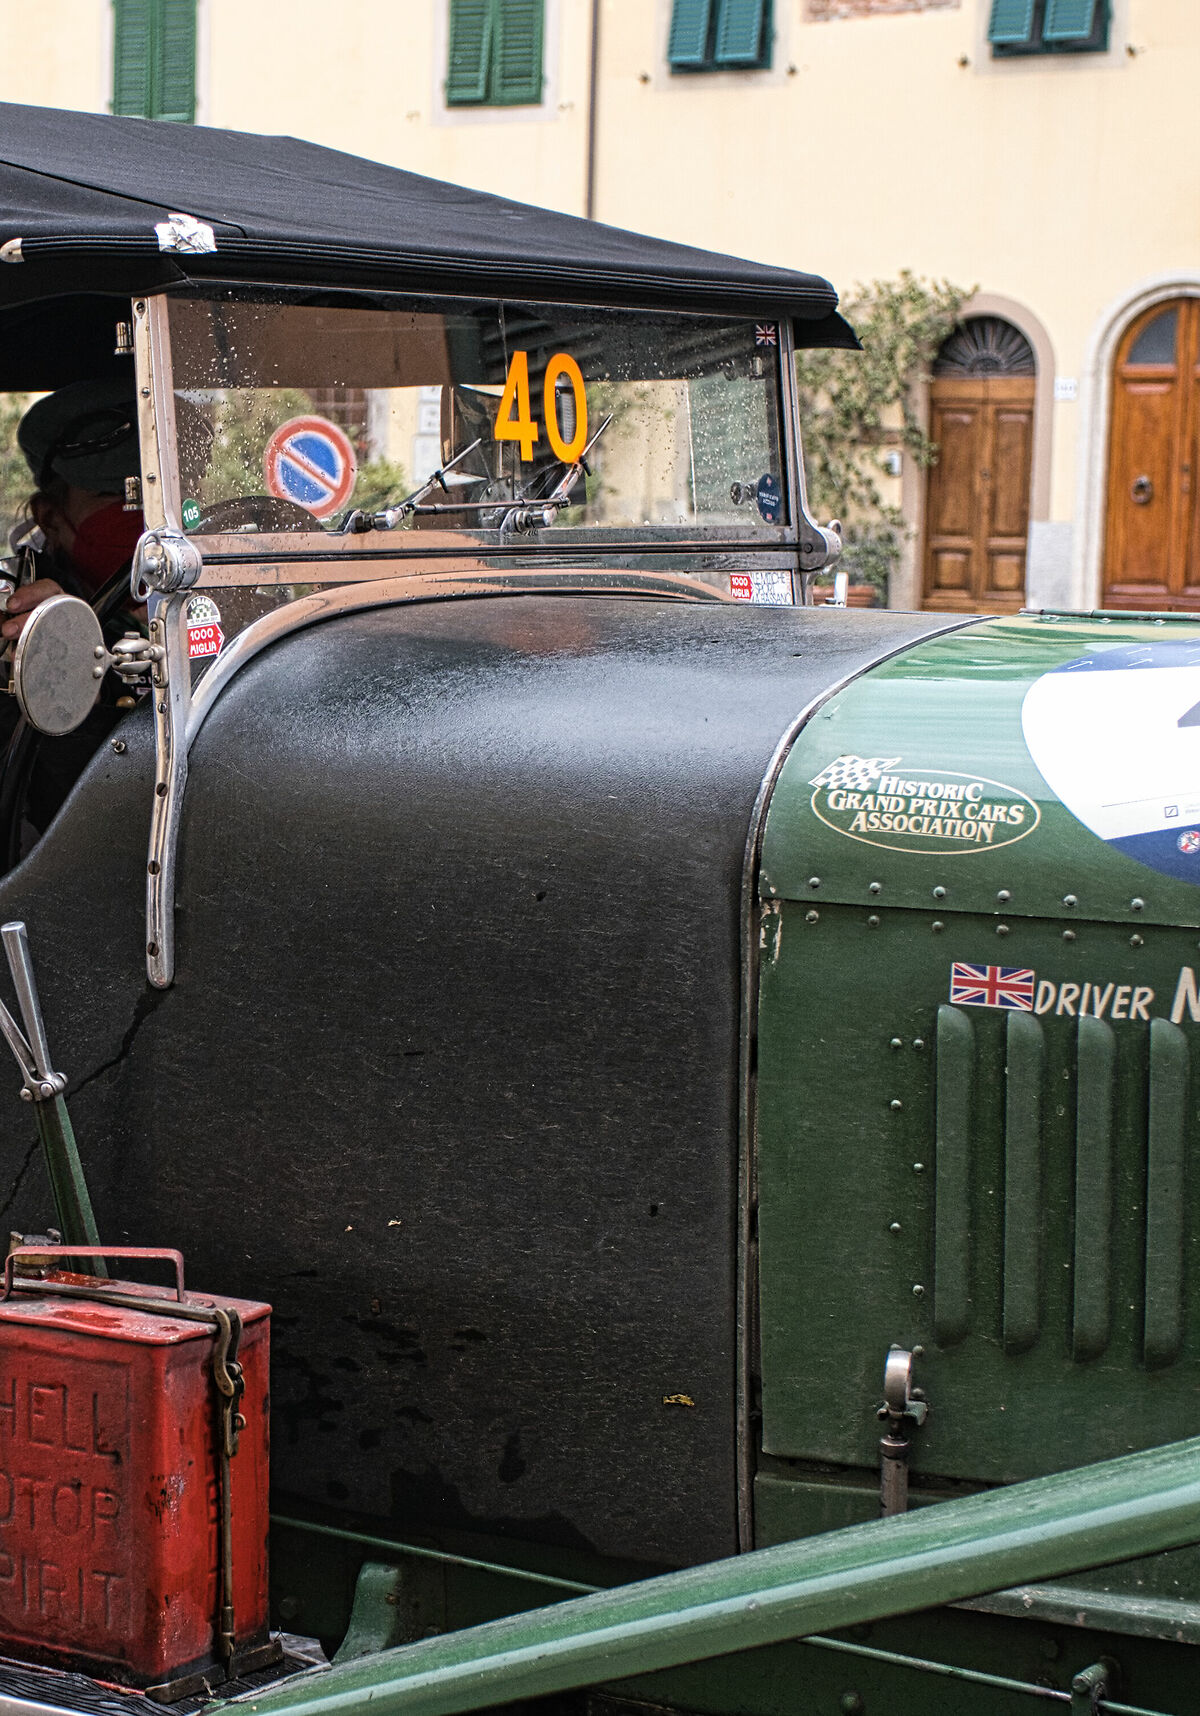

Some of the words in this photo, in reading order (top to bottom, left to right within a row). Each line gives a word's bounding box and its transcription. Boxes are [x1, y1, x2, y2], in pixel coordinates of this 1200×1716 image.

[494, 350, 588, 464] 40
[183, 506, 199, 522] 105
[732, 576, 748, 587] 1000
[190, 628, 214, 641] 1000
[190, 641, 217, 656] MIGLIA
[877, 776, 984, 801] HISTORIC
[827, 790, 906, 813] GRAND
[908, 799, 961, 819] PRIX
[963, 803, 1025, 825] CARS
[848, 812, 996, 843] ASSOCIATION
[1033, 980, 1155, 1021] DRIVER
